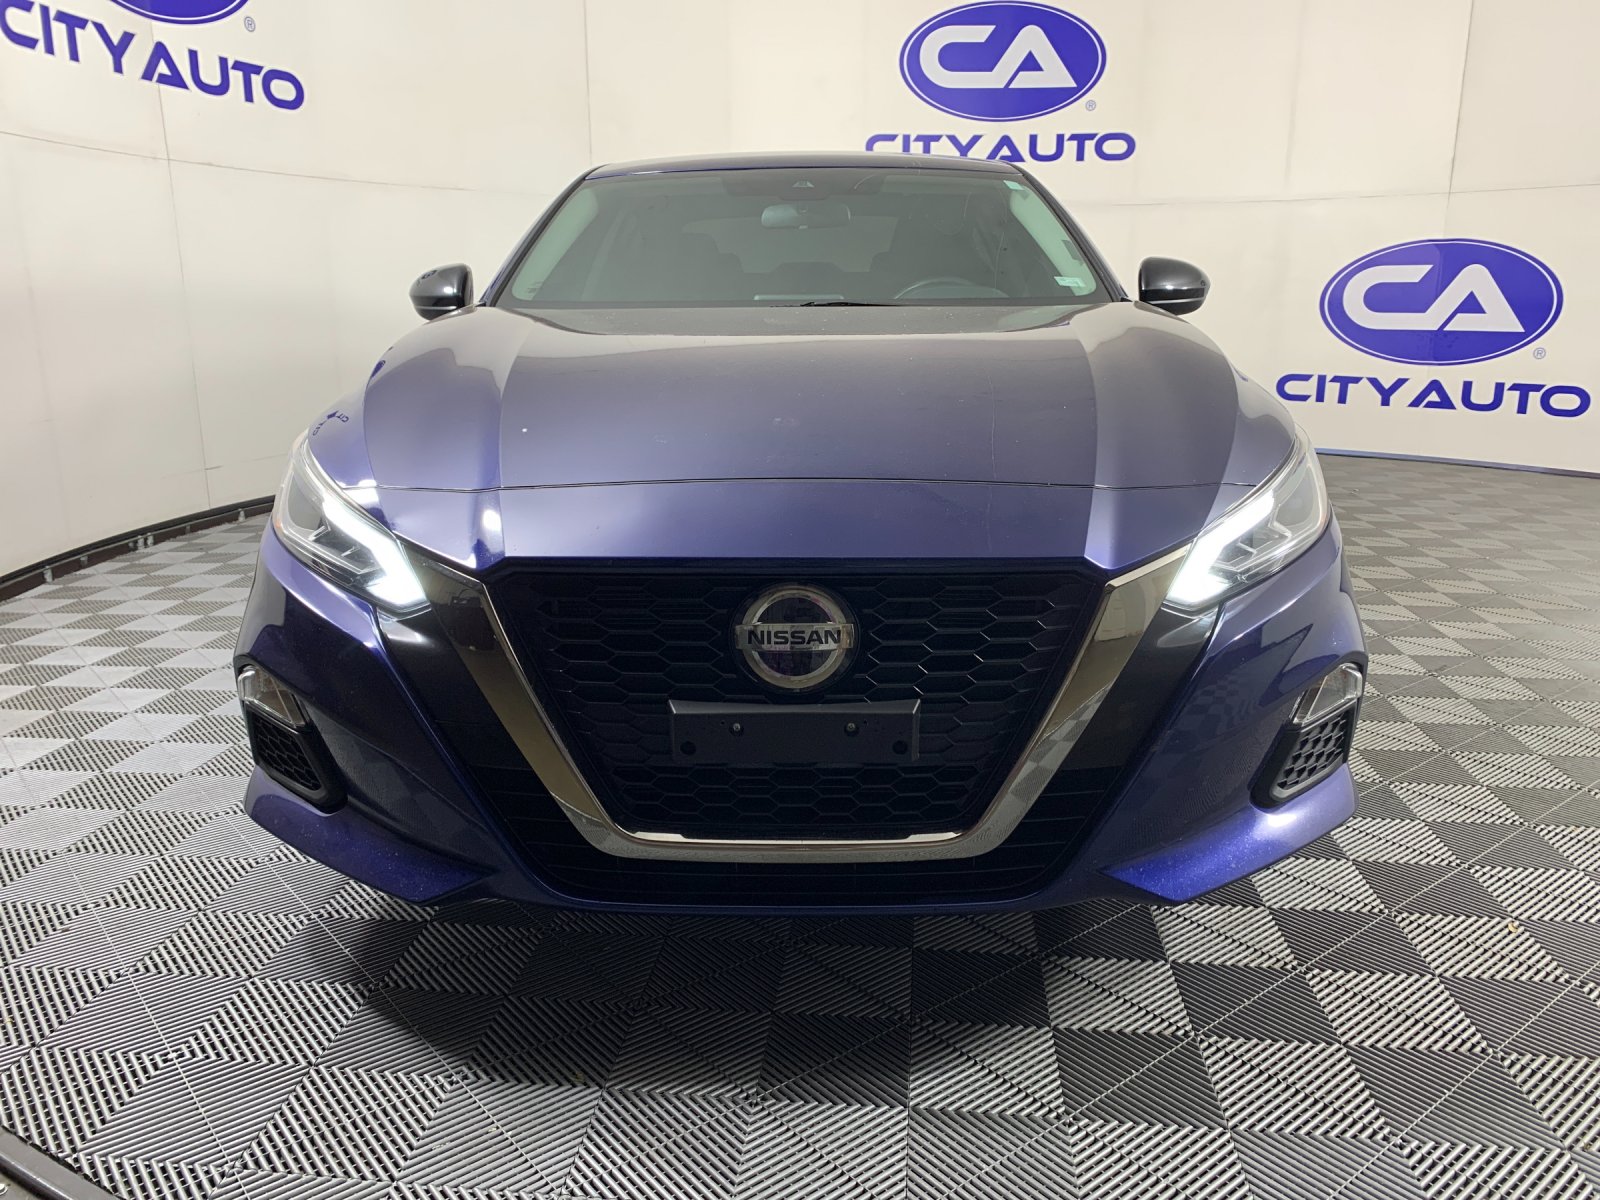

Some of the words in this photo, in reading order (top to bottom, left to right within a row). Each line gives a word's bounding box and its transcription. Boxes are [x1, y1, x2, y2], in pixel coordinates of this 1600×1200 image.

[919, 24, 1078, 89] CA
[1342, 263, 1526, 333] CA
[747, 629, 842, 645] NISSAN
